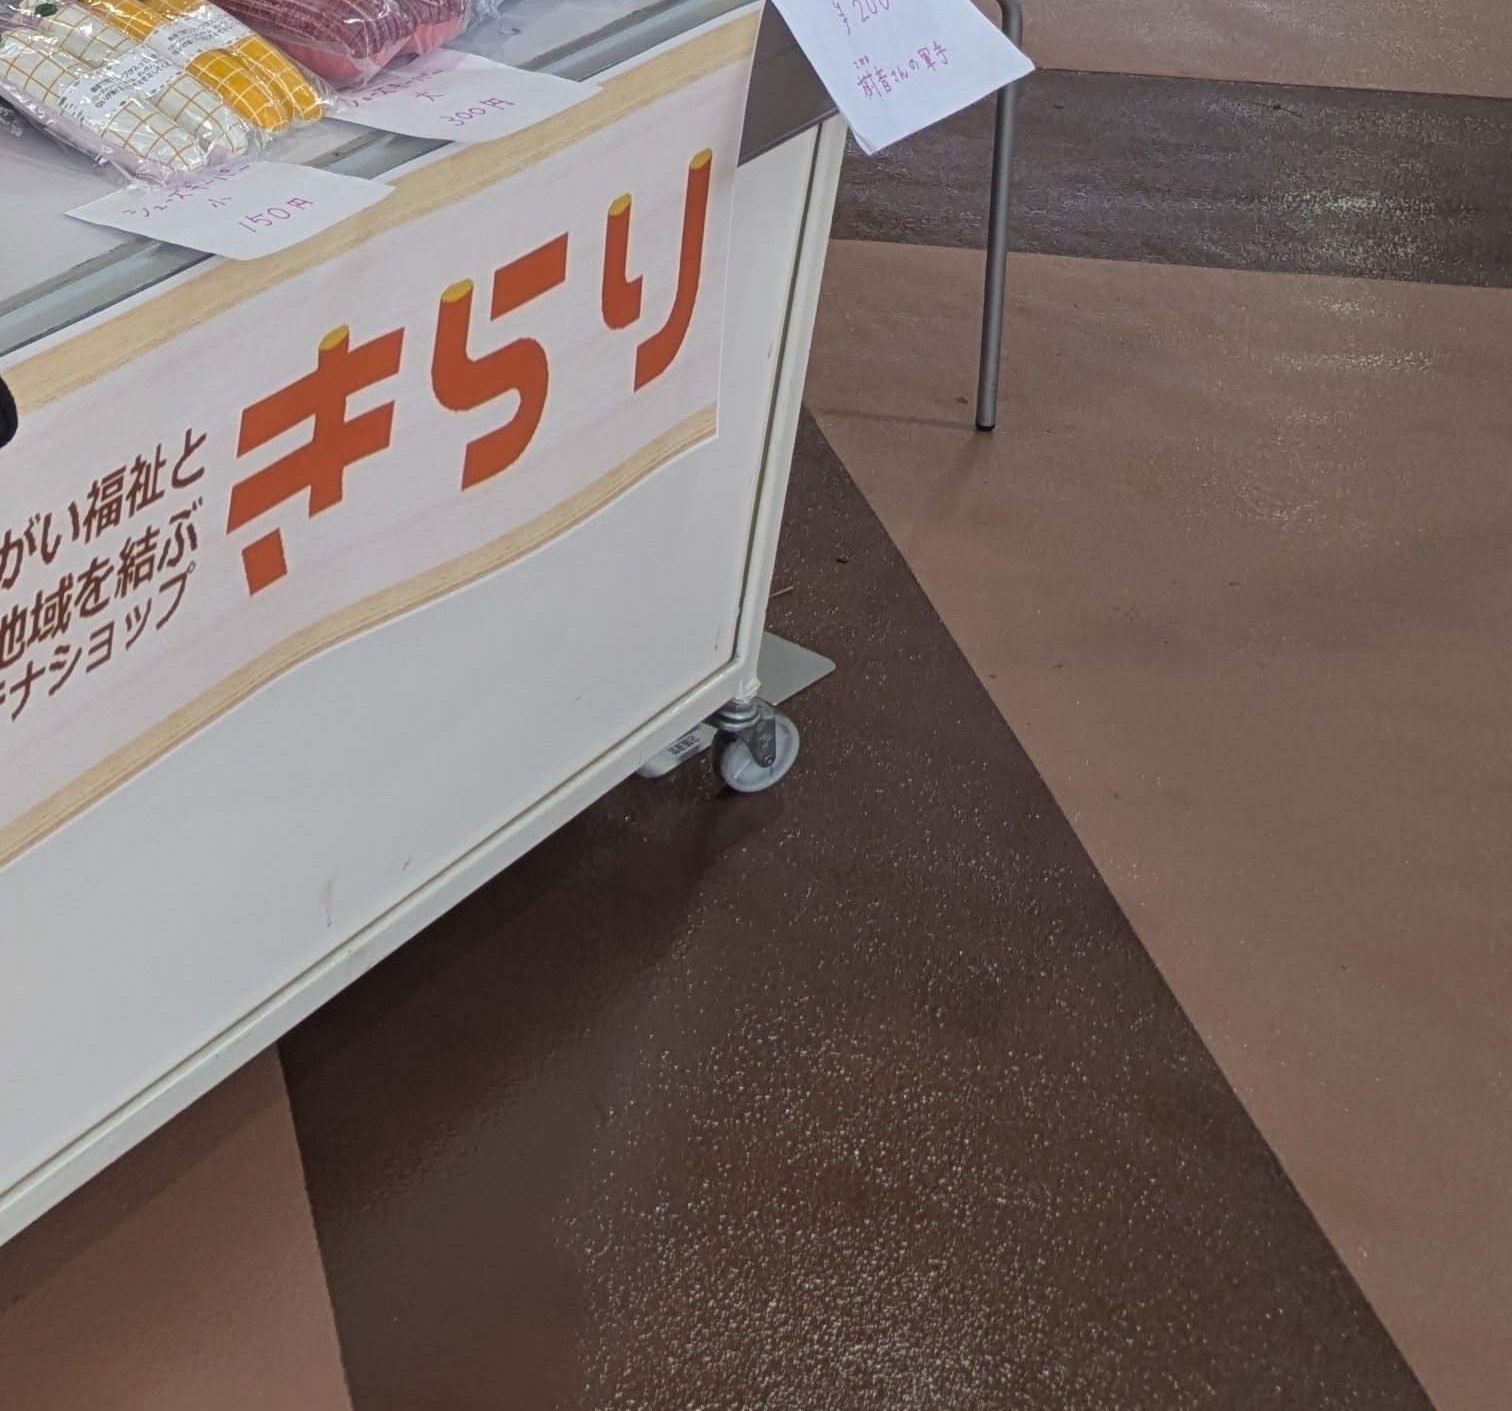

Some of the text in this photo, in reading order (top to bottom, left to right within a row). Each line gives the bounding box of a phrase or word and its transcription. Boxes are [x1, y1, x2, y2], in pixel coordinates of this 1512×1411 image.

[439, 97, 516, 127] 300円
[238, 196, 314, 233] 150円
[226, 147, 712, 597] きらり
